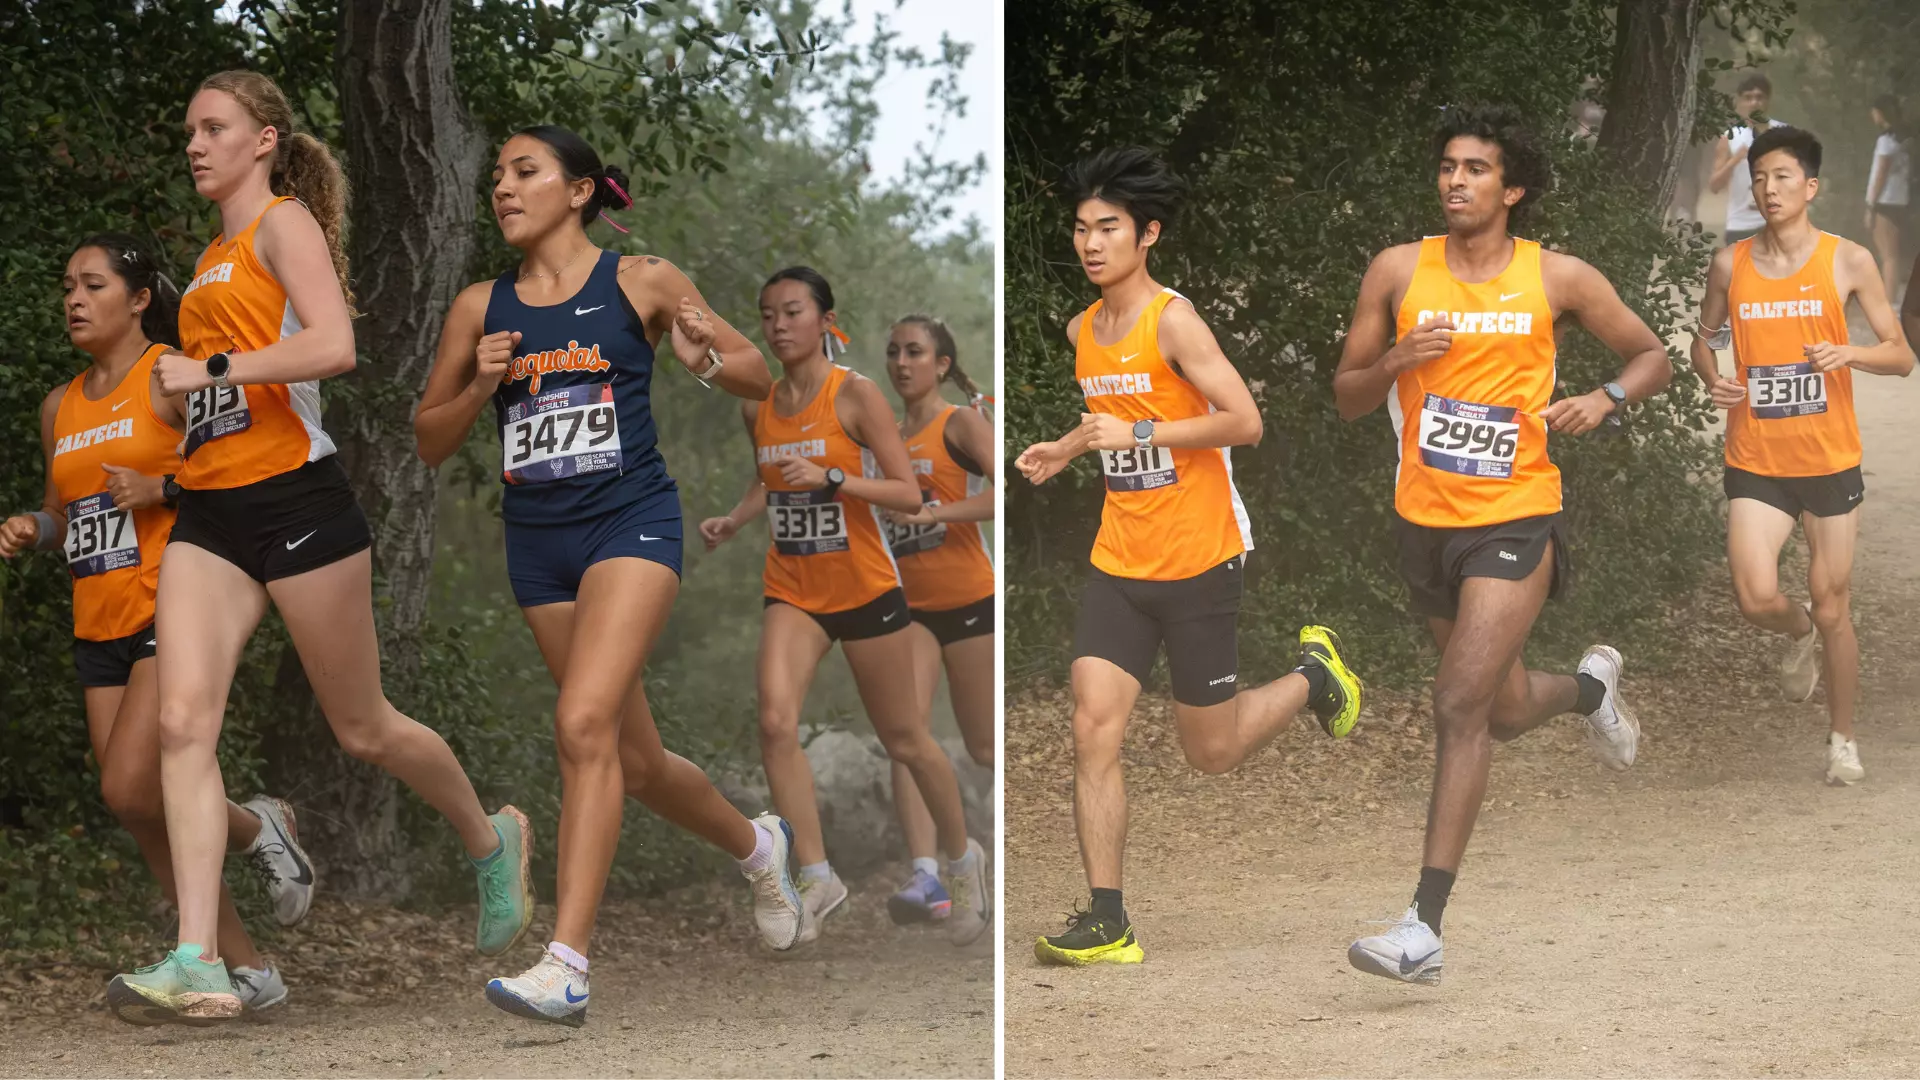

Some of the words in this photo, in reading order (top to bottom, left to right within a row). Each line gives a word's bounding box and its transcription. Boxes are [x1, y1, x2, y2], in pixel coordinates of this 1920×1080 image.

[1739, 300, 1823, 320] CALTECH
[538, 391, 570, 403] FINISHED
[1757, 374, 1822, 405] 3310
[538, 400, 569, 412] RESULTS
[54, 417, 134, 457] CALTECH
[512, 406, 615, 464] 3479
[1426, 415, 1519, 458] 2996
[594, 462, 617, 470] DISCOUNT
[70, 510, 128, 560] 3317
[776, 505, 840, 538] 3313
